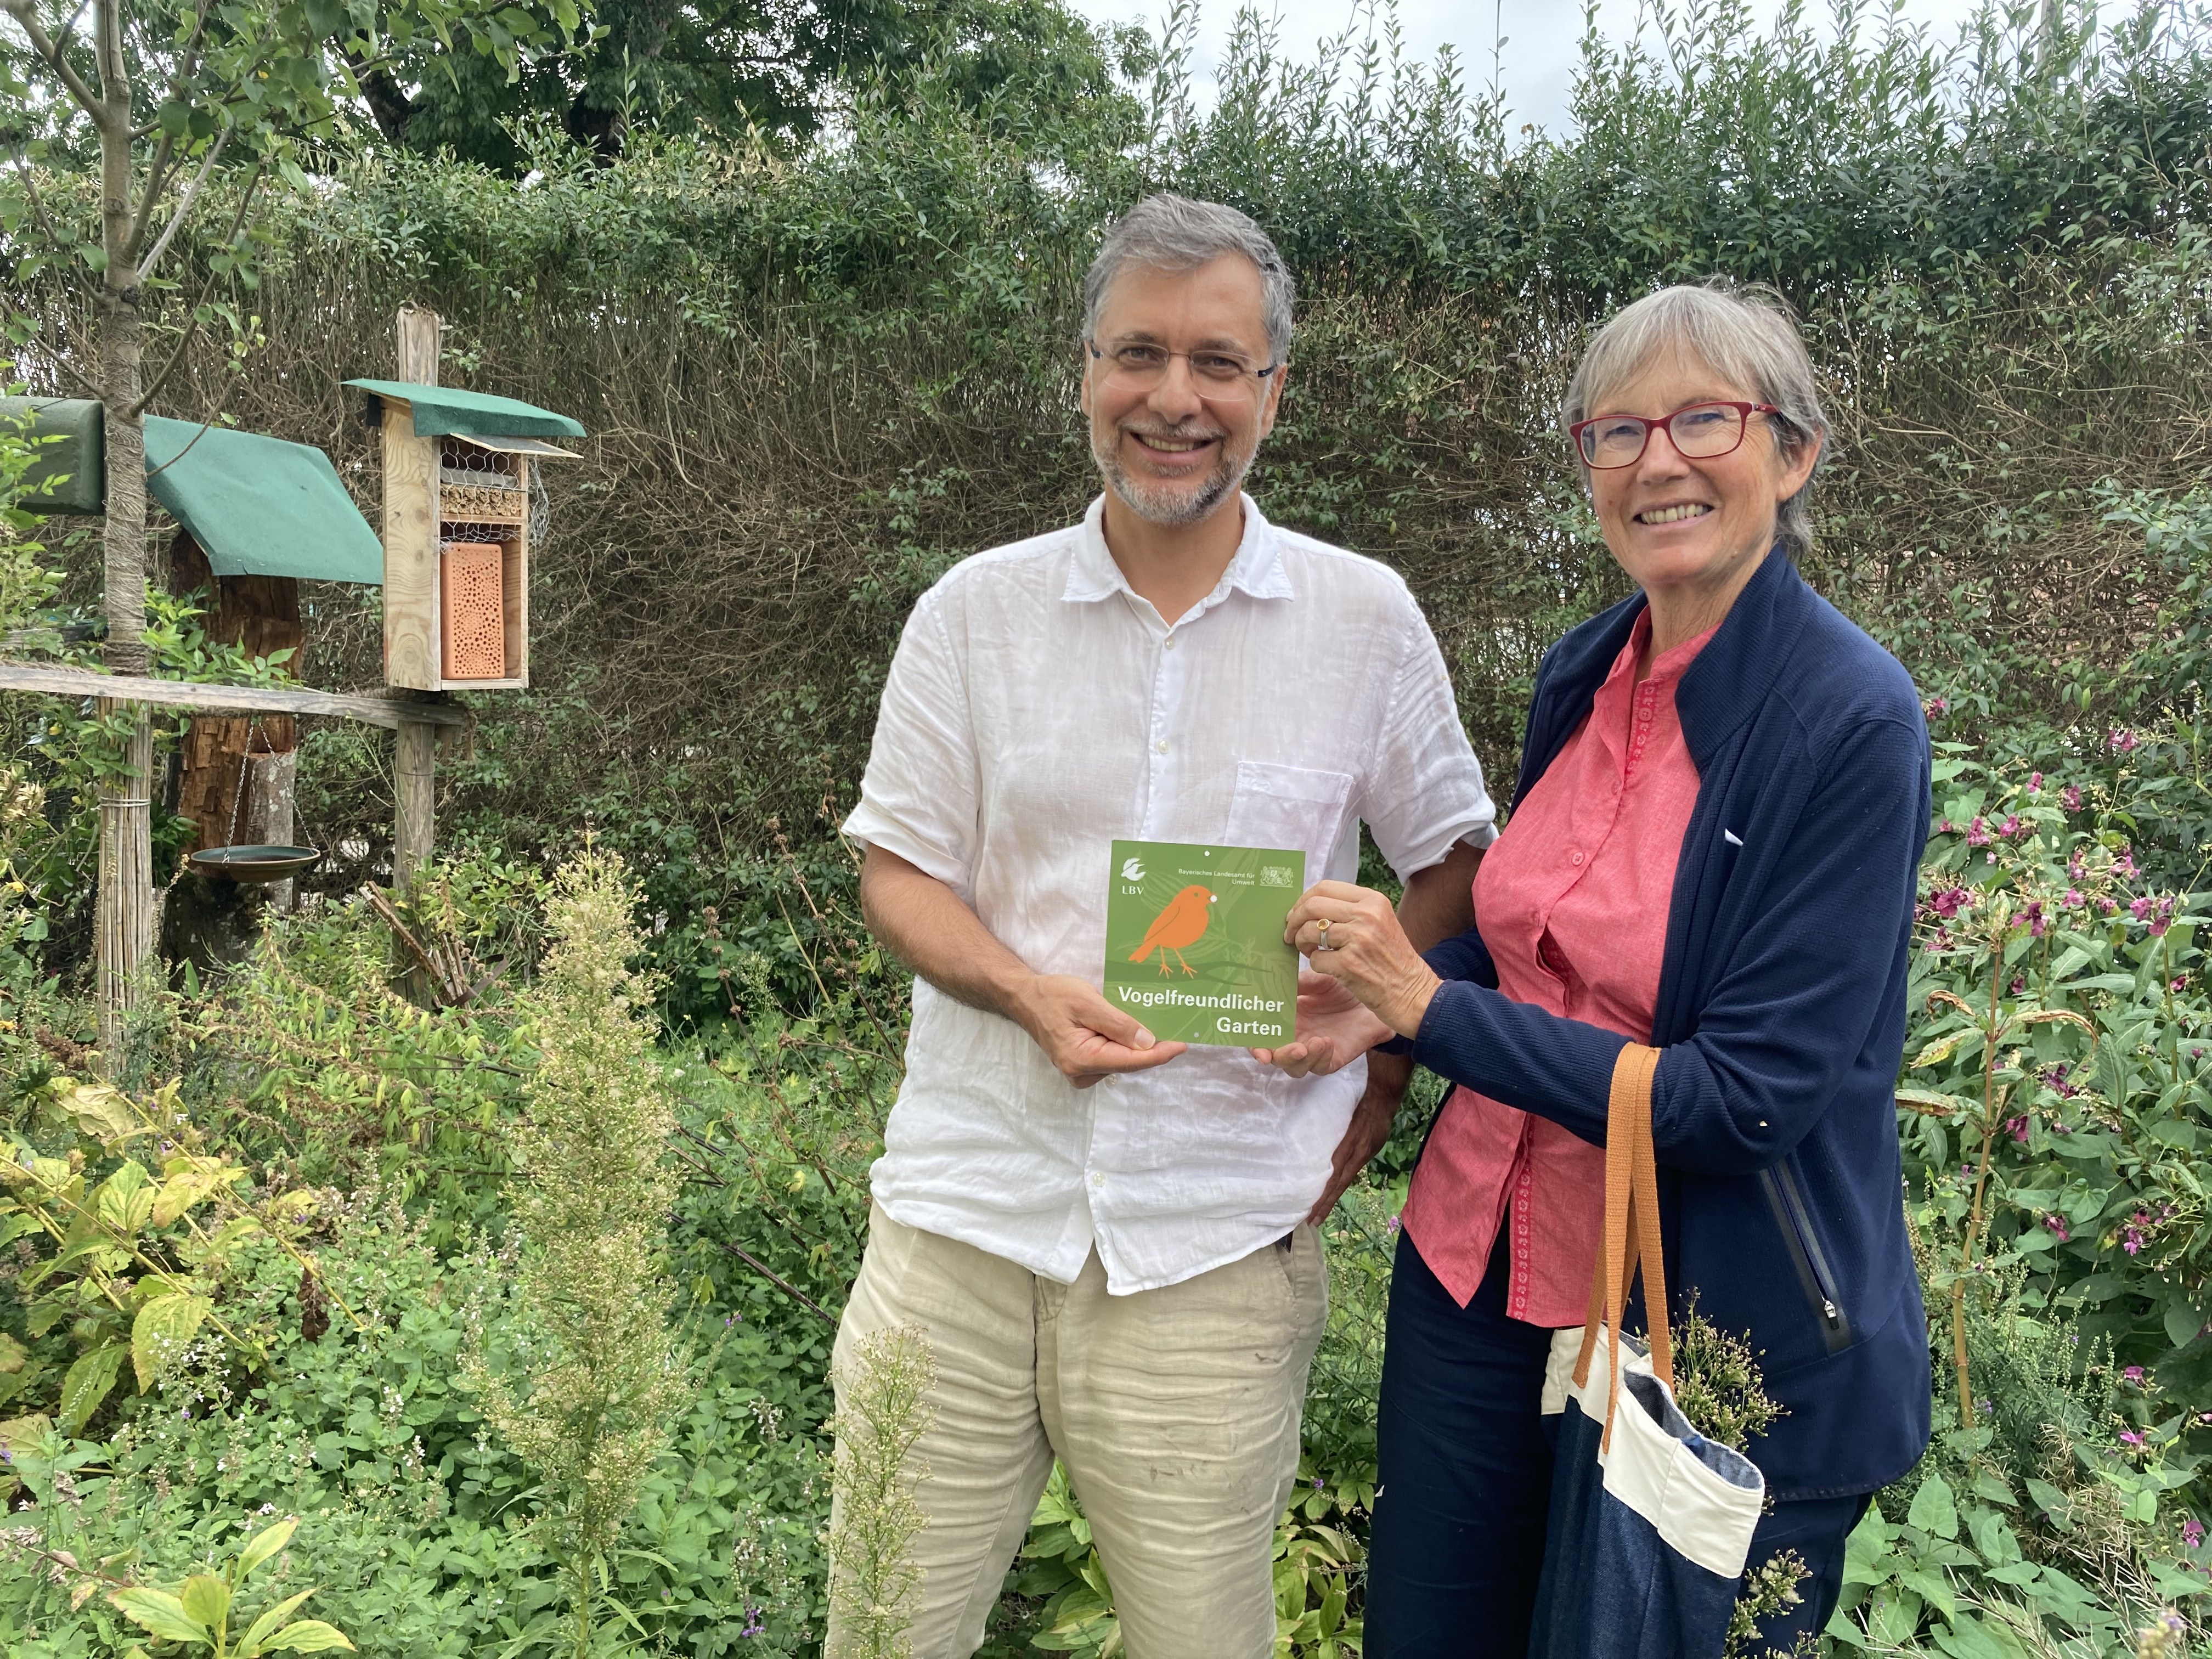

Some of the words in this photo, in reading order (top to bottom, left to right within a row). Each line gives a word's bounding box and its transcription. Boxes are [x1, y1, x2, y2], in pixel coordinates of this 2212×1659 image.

[1178, 868, 1212, 877] Bayerisches
[1122, 885, 1144, 895] LBV
[1118, 986, 1284, 1012] Vogelfreundlicher
[1216, 1017, 1282, 1036] Garten
